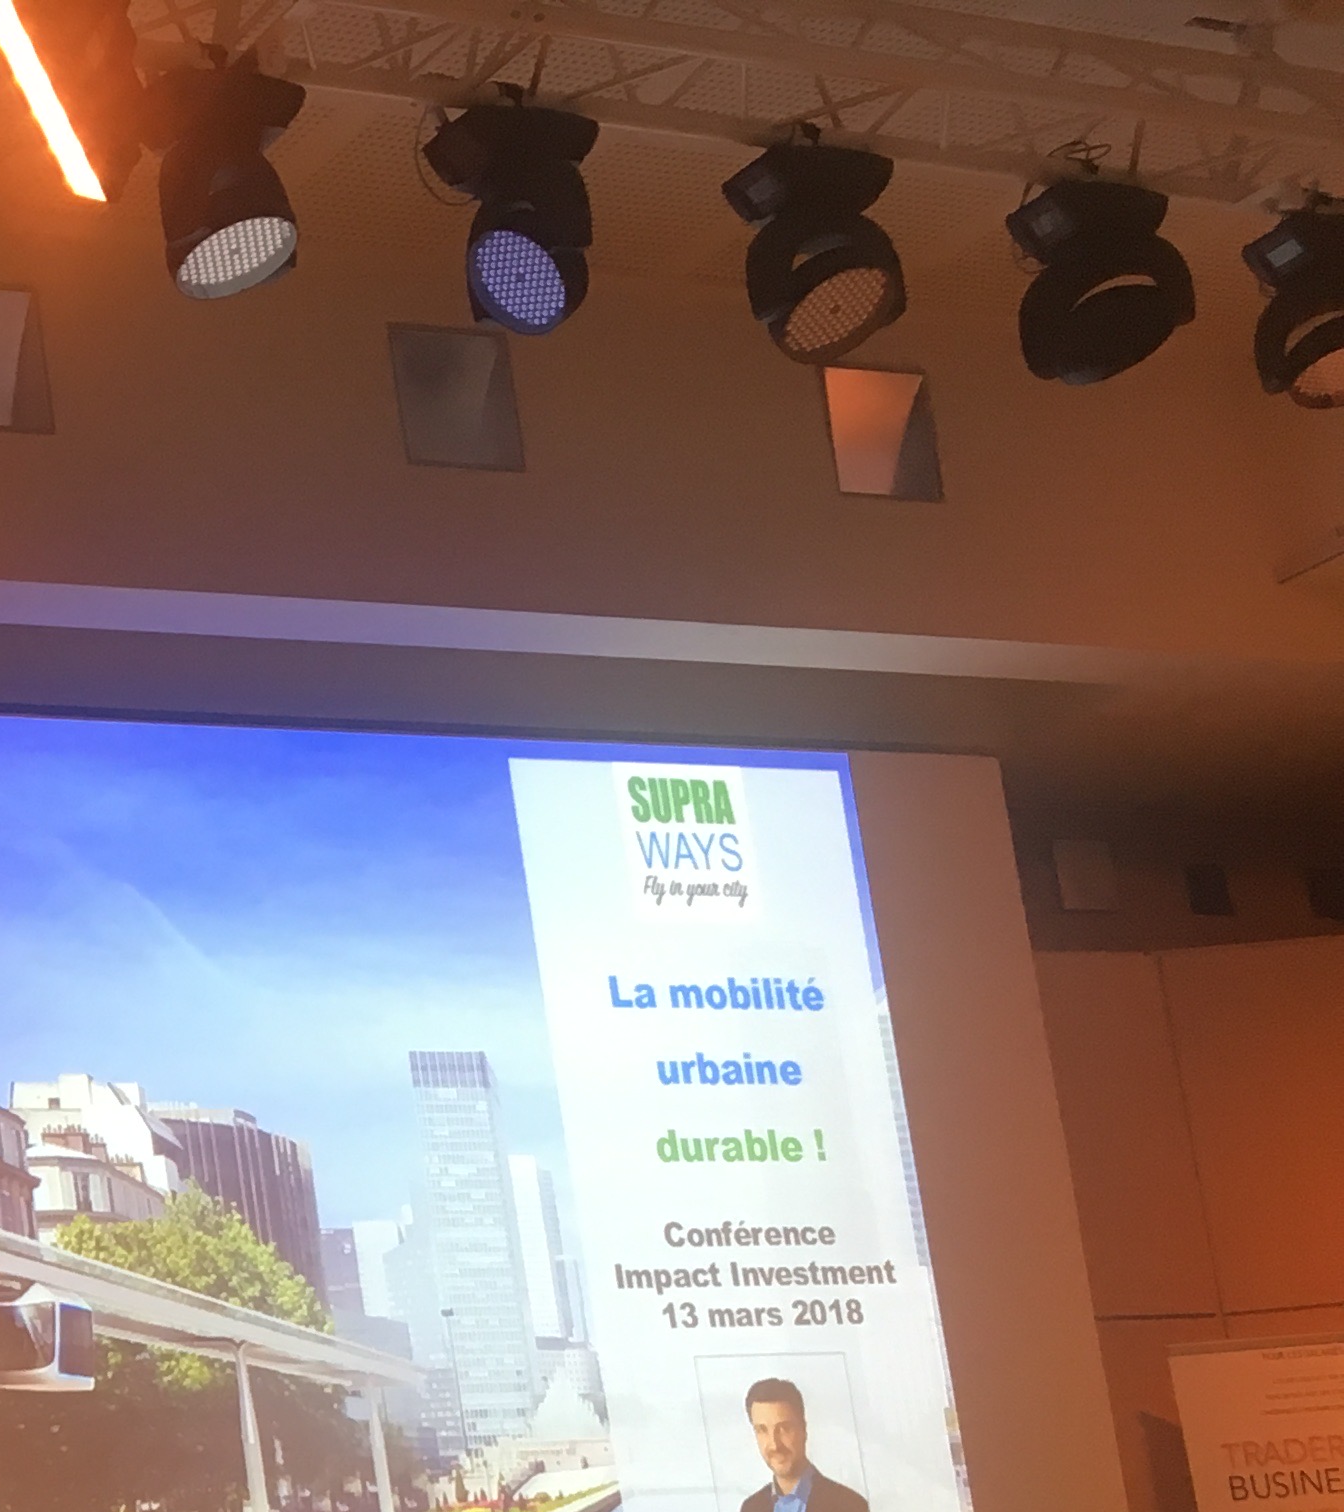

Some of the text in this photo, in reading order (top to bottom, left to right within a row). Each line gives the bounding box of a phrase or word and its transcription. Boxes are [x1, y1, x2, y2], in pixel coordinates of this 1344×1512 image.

[627, 775, 736, 825] SUPRA
[635, 830, 743, 872] WAYS
[643, 875, 748, 908] Fly in your city
[608, 975, 825, 1011] La mobilité
[656, 1052, 802, 1086] urbaine
[656, 1129, 803, 1163] durable
[663, 1220, 836, 1248] Conférence
[614, 1259, 898, 1295] Impact Investment
[662, 1299, 864, 1329] 13 mars 2018
[1228, 1467, 1344, 1501] BUSINE
